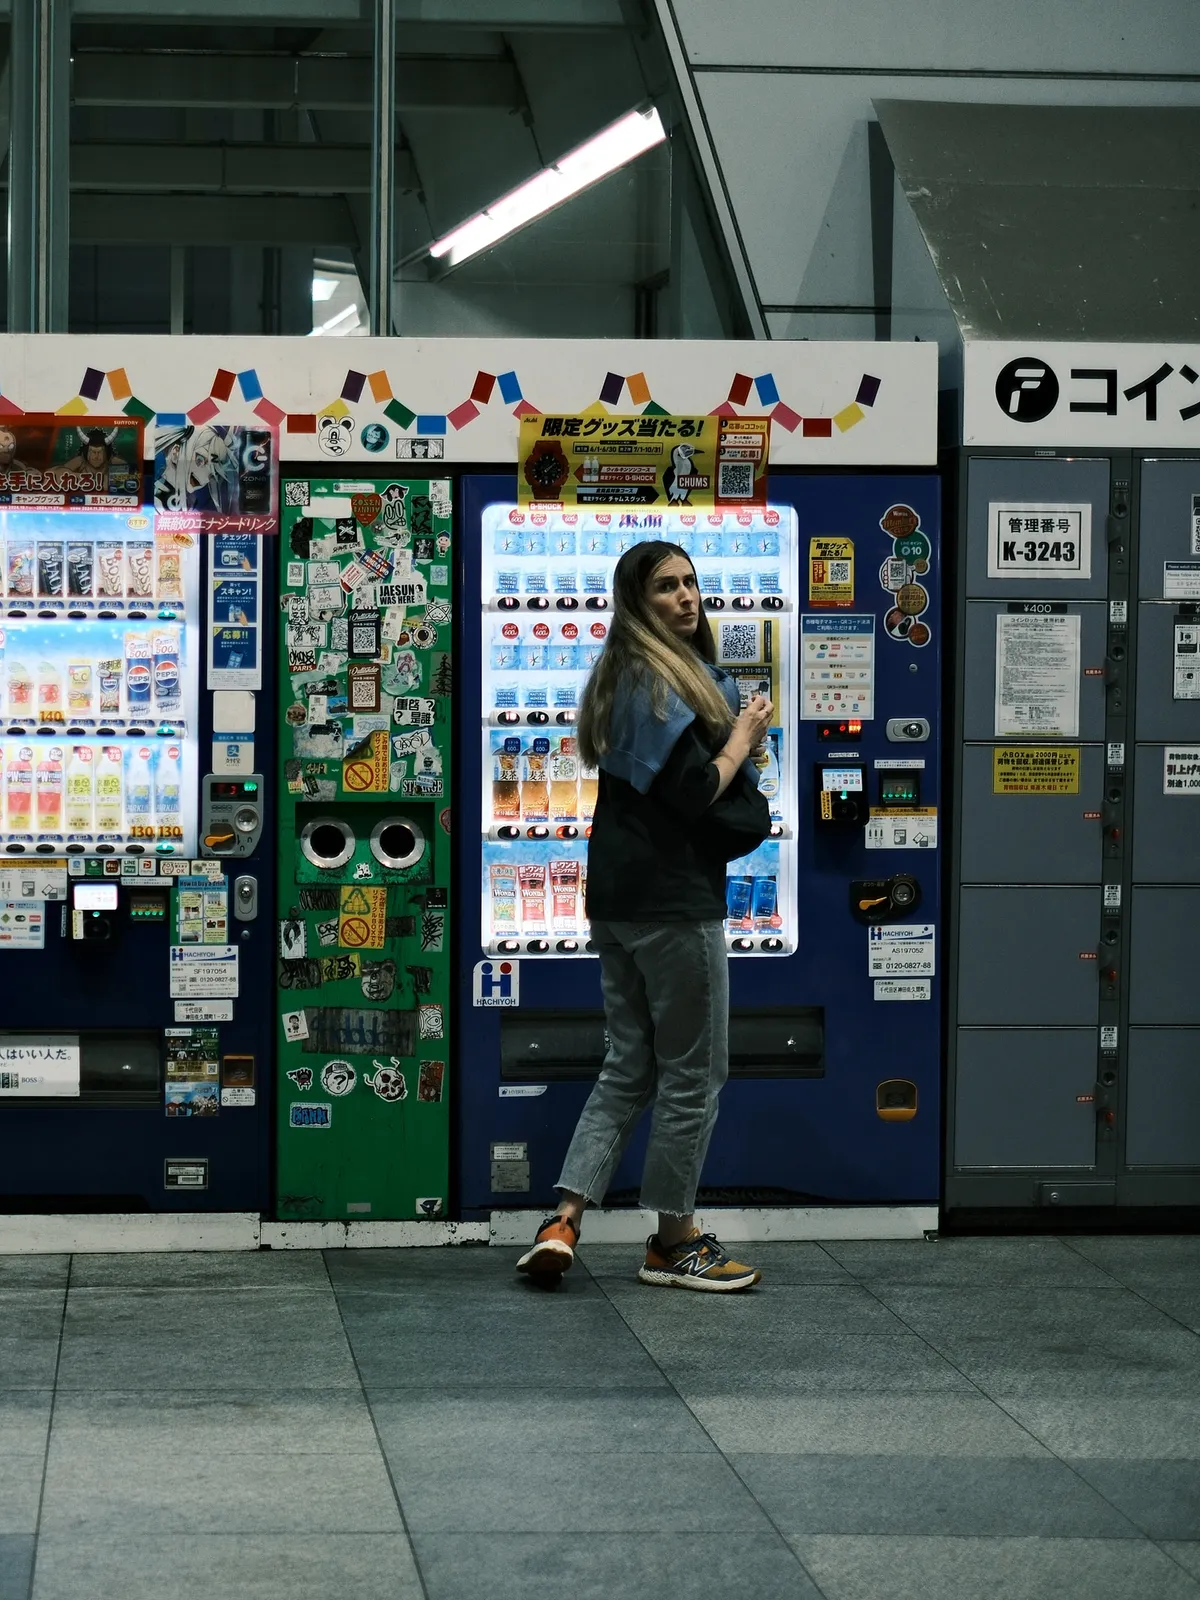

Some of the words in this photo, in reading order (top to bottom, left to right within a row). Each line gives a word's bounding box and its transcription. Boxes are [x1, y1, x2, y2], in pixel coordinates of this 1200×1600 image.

[541, 418, 704, 437] 限定グッズ当たる!
[741, 450, 759, 458] 応募!
[679, 477, 708, 487] CHUMS
[15, 496, 60, 504] キャンプグッズ
[91, 496, 132, 505] 筋トレグッズ
[157, 516, 277, 531] 無敵のエナジードリンク
[1008, 517, 1071, 533] 管理番号
[816, 542, 848, 550] 限定グッズ
[1003, 541, 1075, 561] K-3243
[379, 584, 415, 597] JAESUN
[379, 596, 397, 605] WAS
[398, 596, 415, 605] HERE
[1023, 604, 1052, 613] ¥400
[222, 630, 249, 639] 応募!!
[40, 711, 62, 721] 140
[501, 770, 517, 780] 麦茶
[529, 770, 546, 780] 麦茶
[131, 826, 153, 837] 130
[159, 826, 182, 837] 130
[522, 889, 545, 897] WONDA
[553, 885, 576, 893] WONDA
[476, 998, 516, 1006] HACHIYOH
